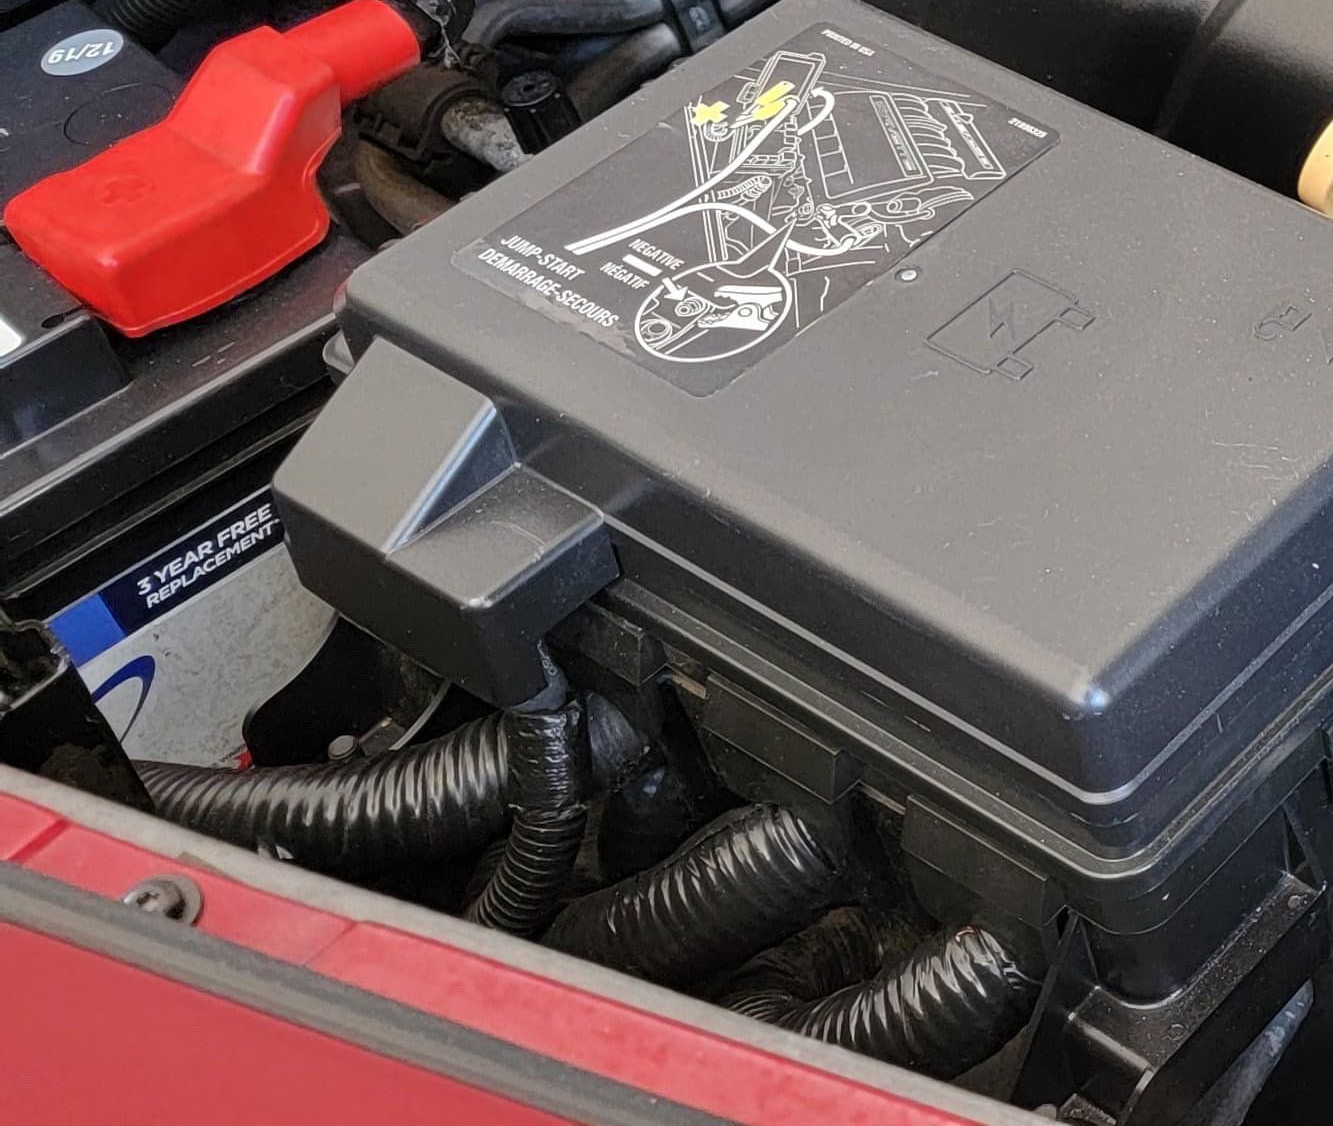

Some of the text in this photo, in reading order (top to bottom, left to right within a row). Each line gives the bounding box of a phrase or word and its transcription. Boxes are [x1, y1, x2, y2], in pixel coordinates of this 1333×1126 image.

[47, 41, 114, 64] 12/19
[500, 235, 586, 281] JUMP-START
[628, 239, 686, 270] NEGATIVE
[478, 248, 620, 327] DEMARRAGE-SECOURS
[600, 261, 650, 291] NÉGATIF
[137, 503, 272, 596] 3 YEAR FREE
